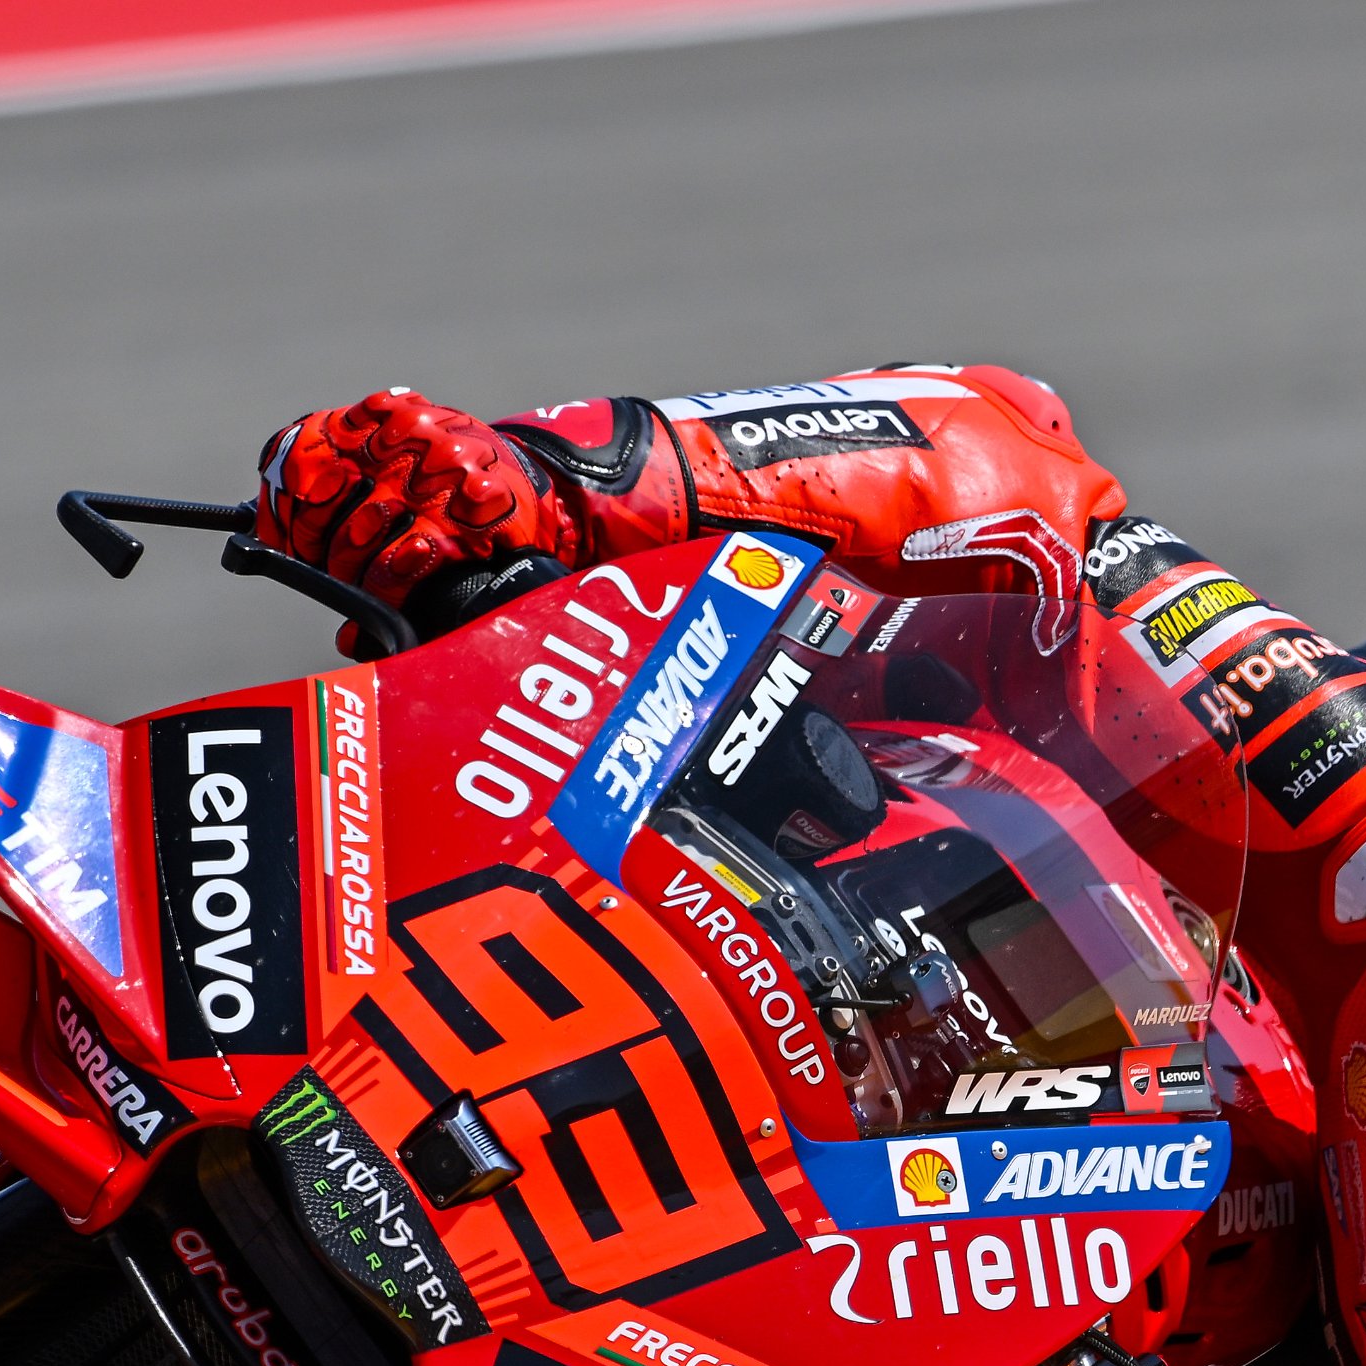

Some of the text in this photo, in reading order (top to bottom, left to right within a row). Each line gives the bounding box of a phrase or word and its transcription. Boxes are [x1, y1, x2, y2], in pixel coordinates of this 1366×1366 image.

[731, 409, 910, 447] Lenovo
[490, 558, 534, 591] domino
[808, 610, 839, 644] Lenovo
[867, 598, 922, 652] MARQUEZ
[455, 602, 632, 817] riello
[595, 597, 734, 813] ADVANCE
[708, 651, 812, 786] WRS
[1290, 711, 1364, 772] ENERGY
[2, 809, 109, 923] TIM
[187, 729, 261, 1034] Lenovo
[333, 684, 375, 976] FRECCIAROSSA
[660, 870, 827, 1087] VARGROUP
[1134, 1003, 1212, 1026] MARQUEZ
[55, 995, 165, 1145] CARRERA
[363, 872, 775, 1300] 93
[944, 1065, 1112, 1115] WRS
[1160, 1071, 1201, 1084] Lenovo
[985, 1141, 1213, 1202] ADVANCE
[1218, 1181, 1295, 1237] DUCATI
[313, 1178, 413, 1322] ENERGY
[315, 1128, 464, 1345] MONSTER
[887, 1218, 1132, 1319] riello
